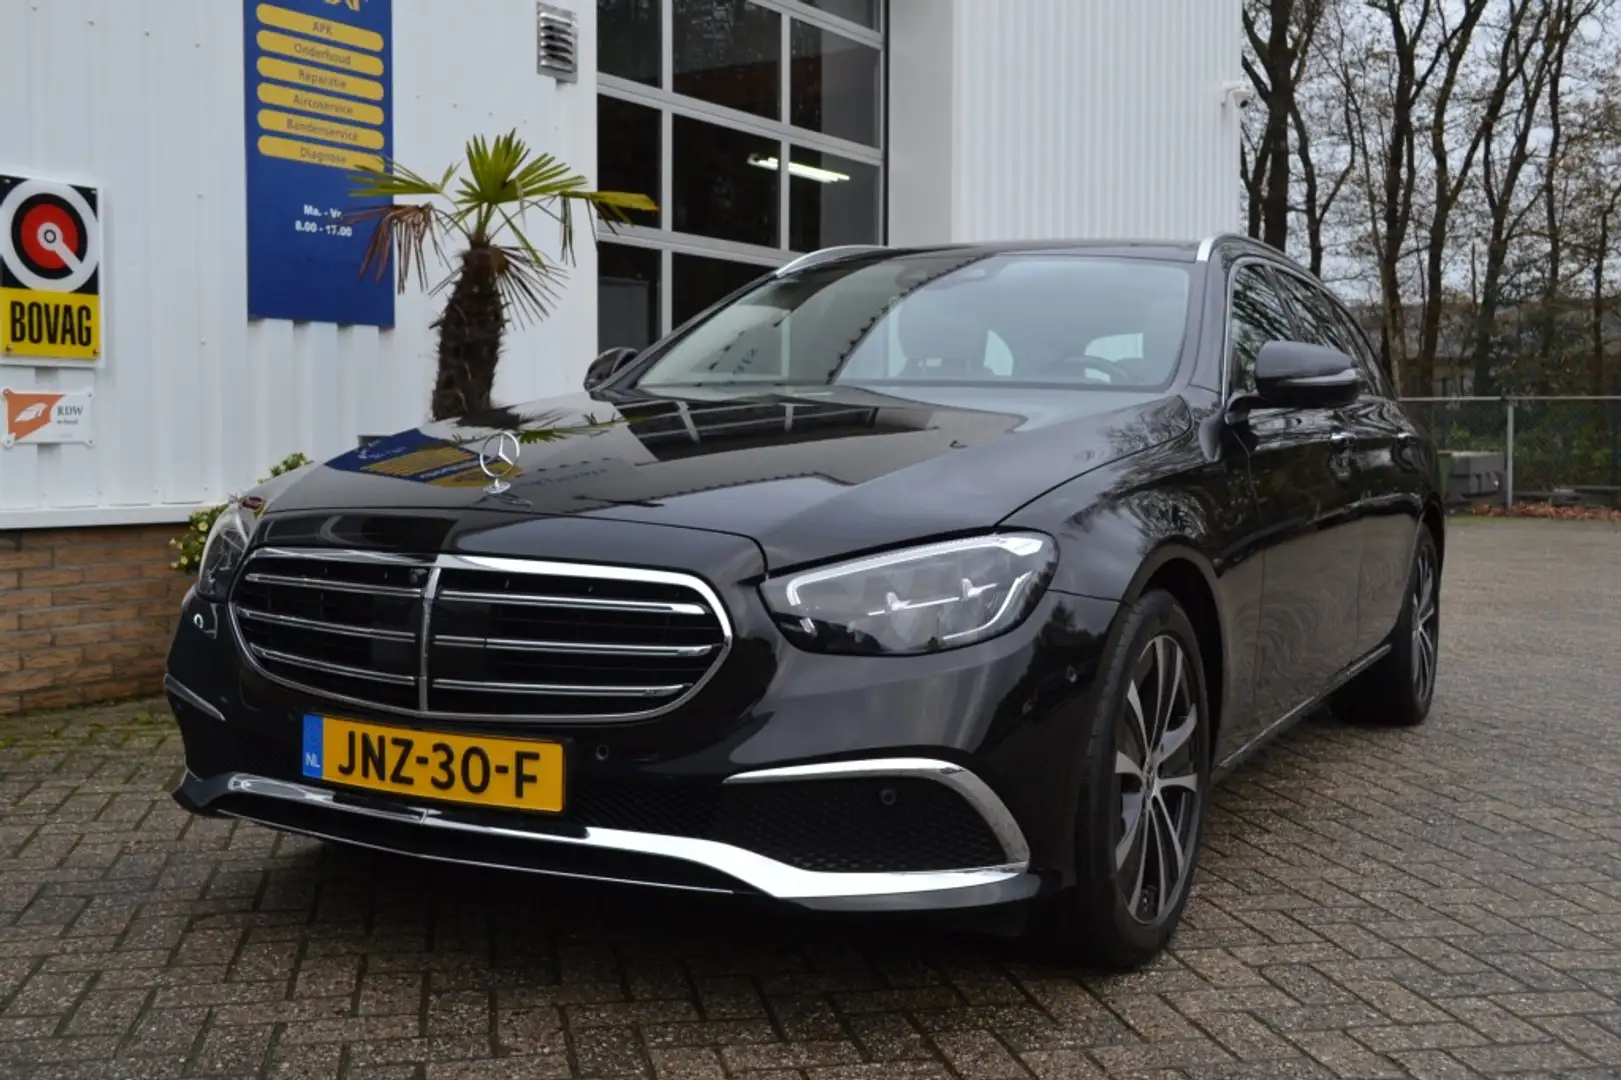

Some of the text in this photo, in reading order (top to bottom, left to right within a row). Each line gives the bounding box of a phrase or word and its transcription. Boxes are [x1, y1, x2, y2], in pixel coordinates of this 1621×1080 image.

[312, 22, 333, 35] APK
[294, 43, 351, 65] Onderhoud
[298, 69, 347, 89] Reparatie
[300, 147, 347, 165] Diagnose
[325, 224, 353, 237] 17.00
[10, 300, 92, 347] BOVAG
[57, 405, 84, 416] RDW
[305, 752, 320, 769] NL
[338, 730, 541, 798] JNZ-30-F
